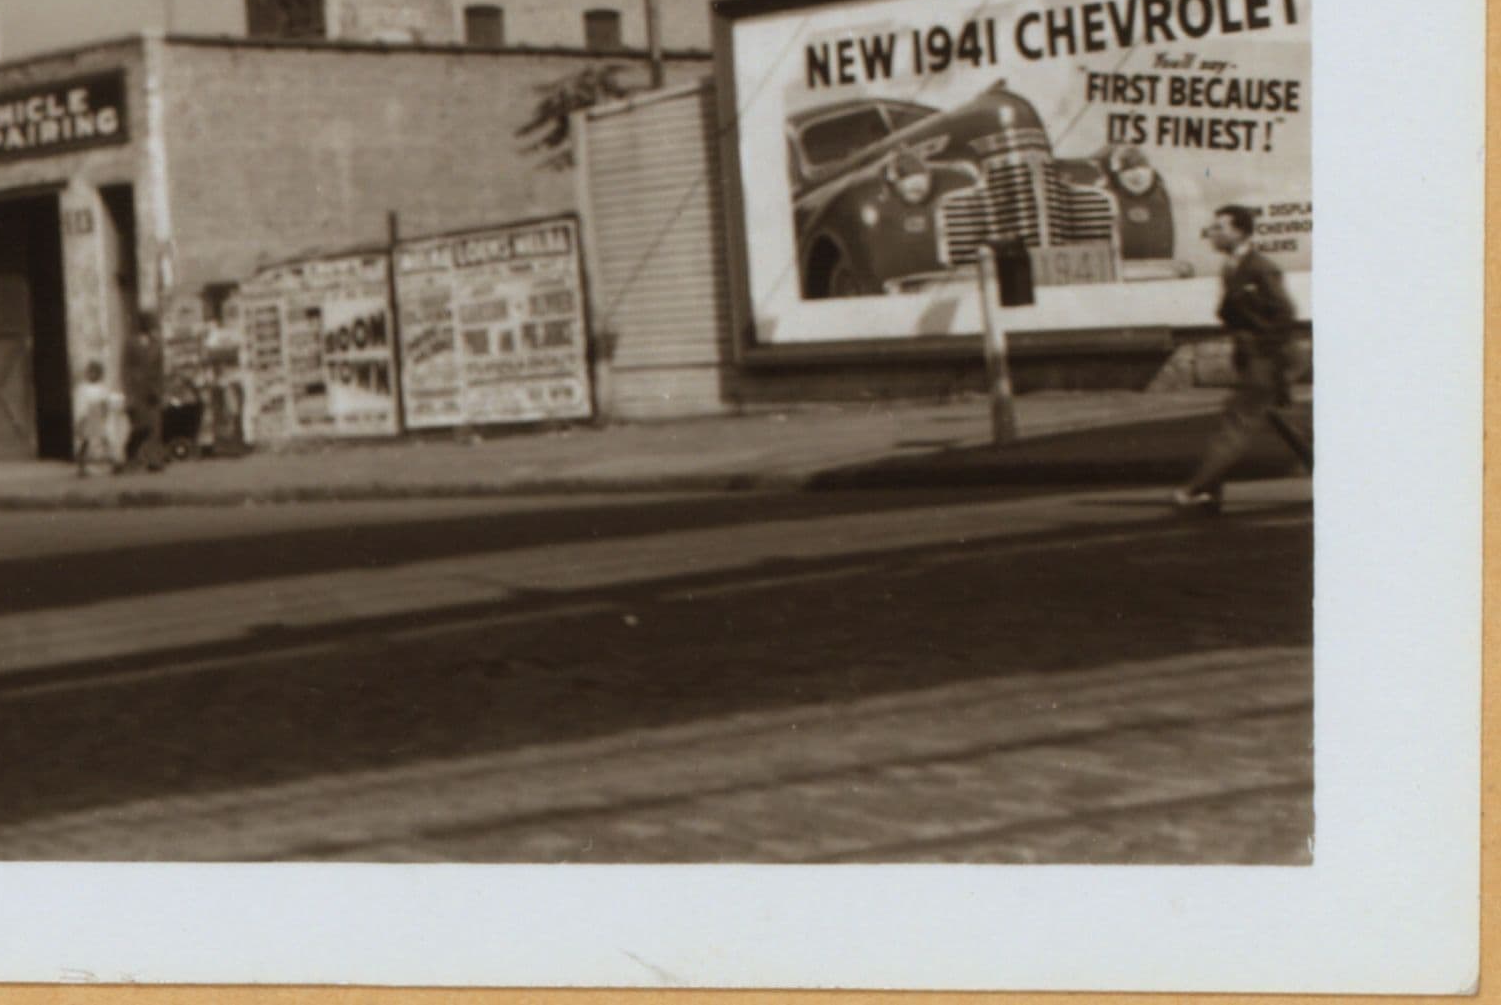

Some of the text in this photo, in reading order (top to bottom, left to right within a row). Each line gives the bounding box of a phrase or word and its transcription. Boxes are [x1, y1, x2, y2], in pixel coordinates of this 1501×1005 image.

[806, 33, 896, 88] NEW
[913, 17, 997, 76] 1941
[1168, 75, 1300, 113] BECAUSE
